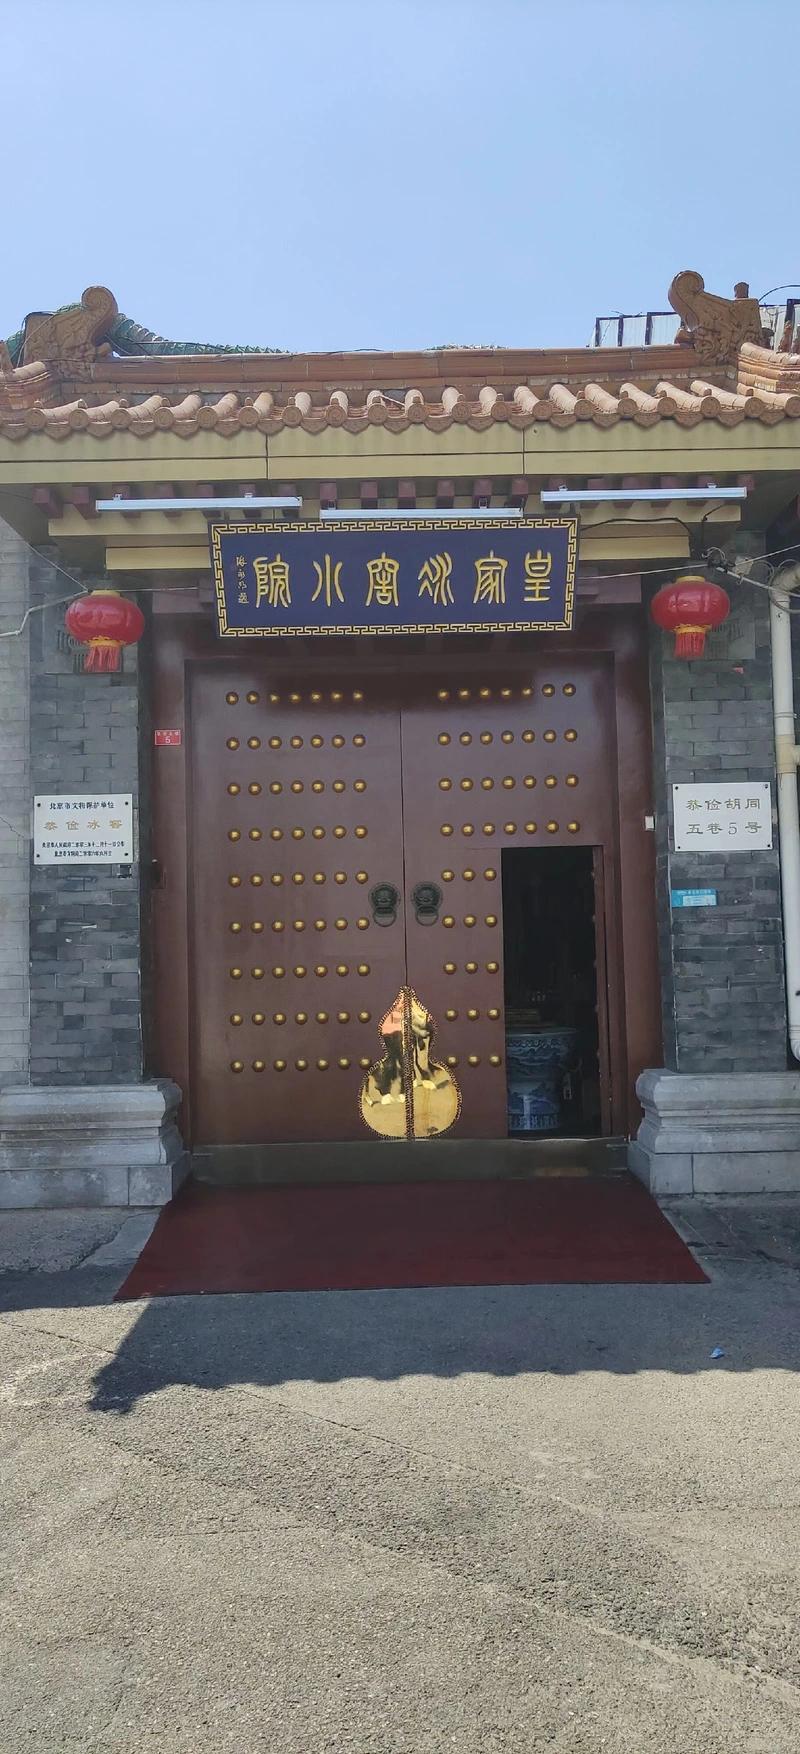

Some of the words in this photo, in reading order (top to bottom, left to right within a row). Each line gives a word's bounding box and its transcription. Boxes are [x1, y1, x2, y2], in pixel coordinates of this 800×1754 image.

[686, 798, 761, 811] 恭俭胡同
[686, 822, 762, 835] 五巷5号
